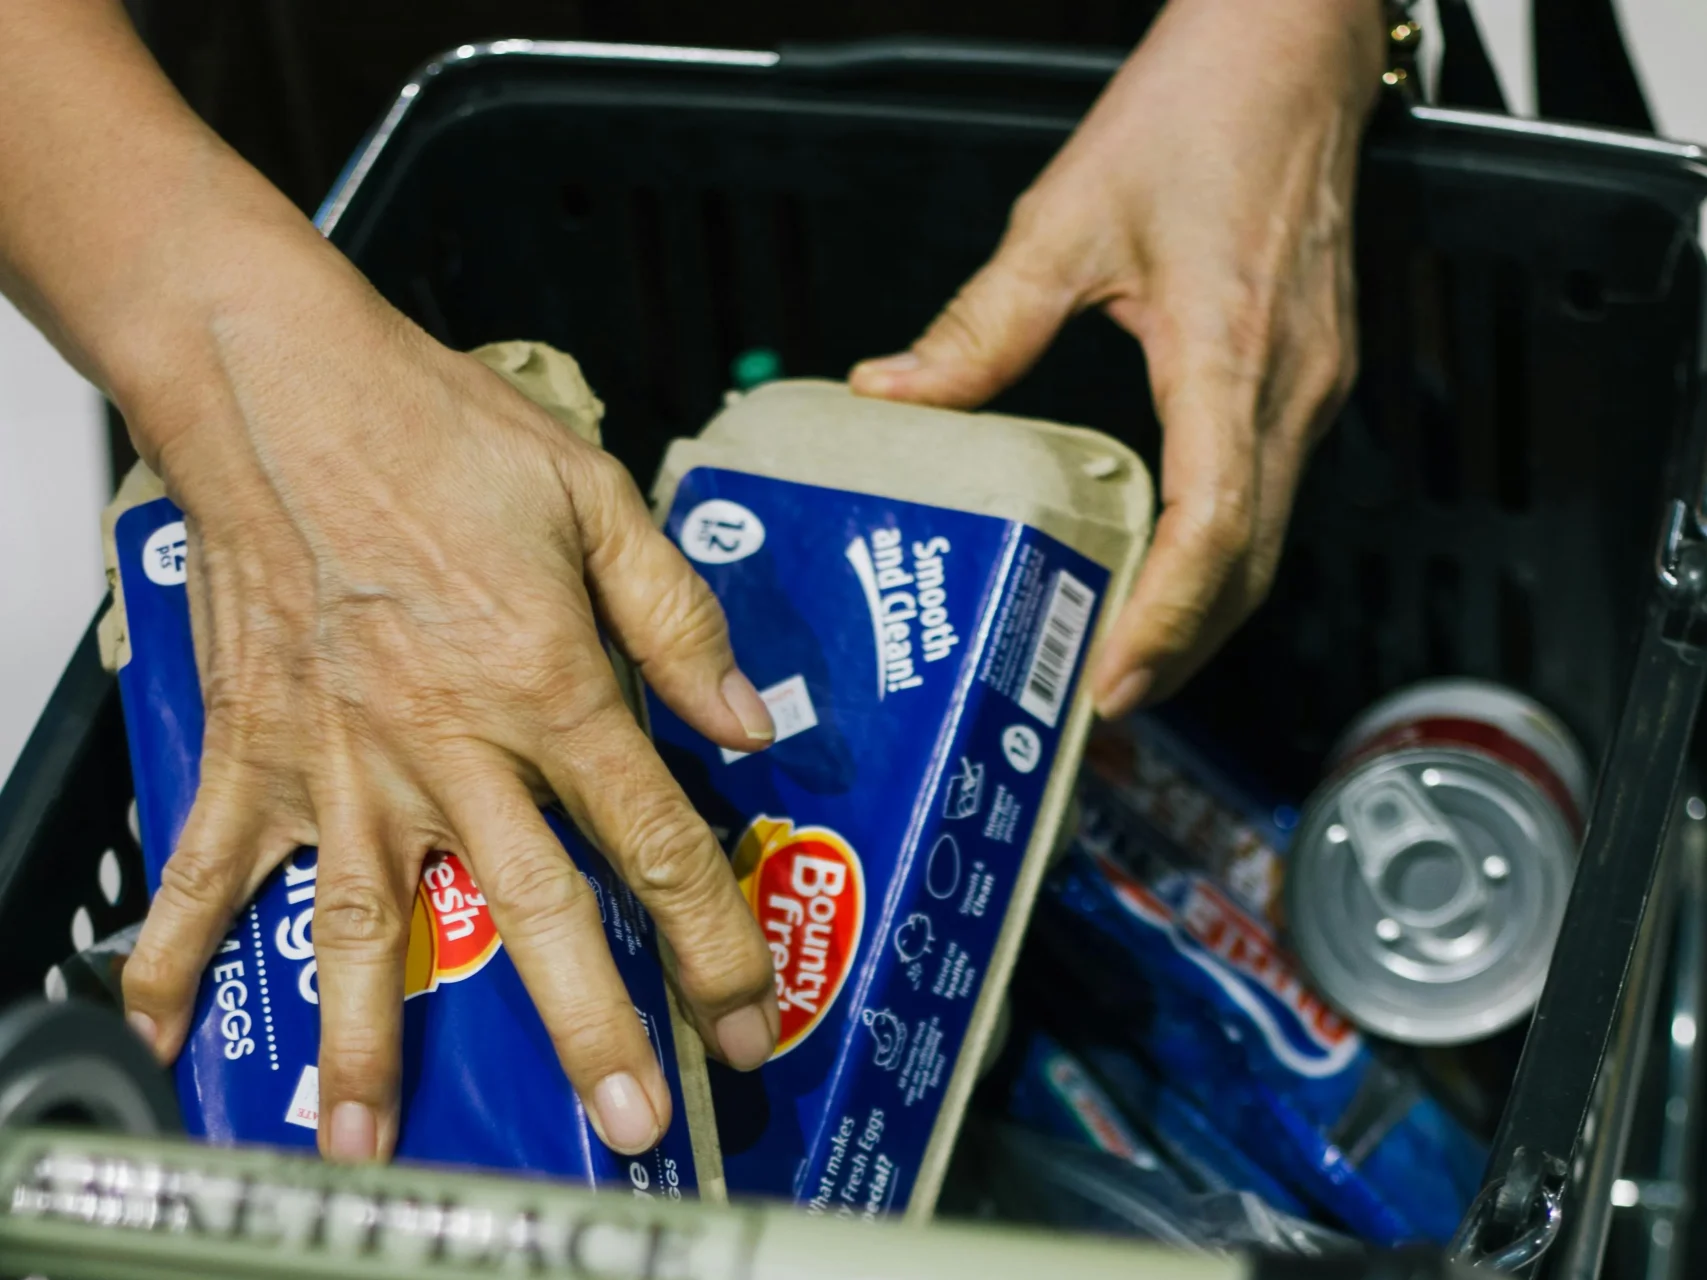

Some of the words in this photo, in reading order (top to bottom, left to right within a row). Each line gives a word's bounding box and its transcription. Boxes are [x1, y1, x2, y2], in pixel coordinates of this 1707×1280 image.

[155, 546, 172, 569] pcs
[708, 519, 746, 553] 12
[871, 526, 914, 591] and
[911, 536, 960, 663] Smooth
[882, 591, 924, 693] Clean!
[958, 872, 980, 916] Smooth
[972, 874, 994, 917] Clean
[626, 935, 636, 956] eggs
[786, 854, 847, 1014] Bounty
[932, 956, 951, 995] Raised
[944, 950, 969, 1001] healthy
[213, 960, 255, 1061] EGGS
[826, 1115, 855, 1176] makes
[840, 1153, 869, 1202] Fresh
[857, 1107, 885, 1151] Eggs
[664, 1158, 682, 1203] GGS
[862, 1153, 893, 1223] pecial?
